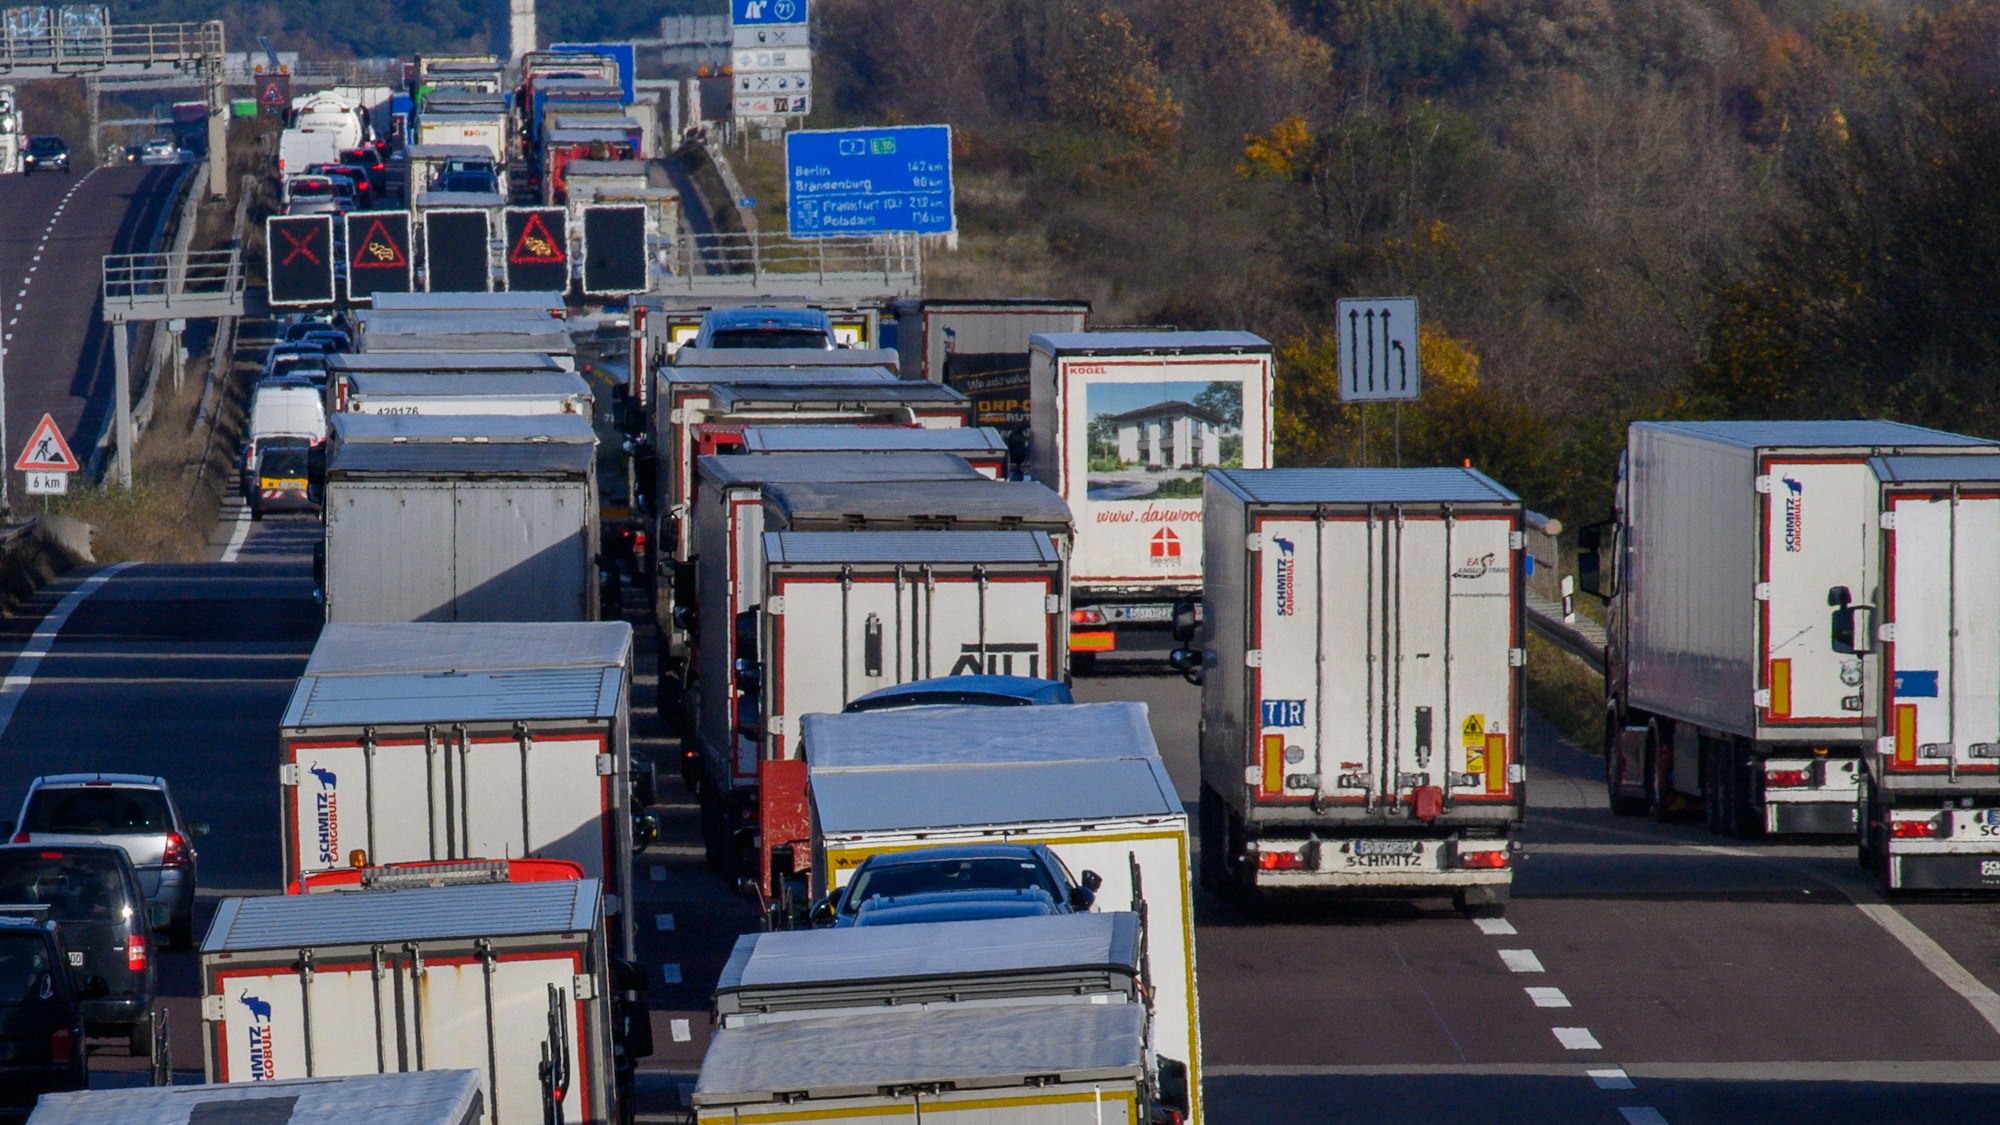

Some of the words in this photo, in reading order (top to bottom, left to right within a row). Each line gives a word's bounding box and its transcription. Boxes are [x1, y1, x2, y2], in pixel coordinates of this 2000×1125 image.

[795, 165, 831, 177] Berlin
[928, 163, 943, 171] km
[795, 179, 873, 193] Brandenburg
[929, 178, 943, 187] km
[822, 199, 879, 213] Frankfurt
[930, 199, 945, 207] km
[823, 214, 876, 227] Potsdam
[930, 213, 945, 223] km
[377, 406, 419, 416] 420176
[33, 475, 40, 488] 6
[44, 475, 61, 489] km
[1786, 498, 1794, 552] SCHMITZ
[1457, 566, 1482, 574] ANGLO
[1487, 566, 1509, 574] TRANS
[1277, 558, 1286, 616] SCHMITZ
[1264, 701, 1301, 725] TIR
[317, 792, 331, 863] SCHMITZ
[328, 791, 339, 863] CARGOBULL
[1346, 854, 1422, 867] SCHMITZ
[261, 1025, 275, 1080] GOBULL
